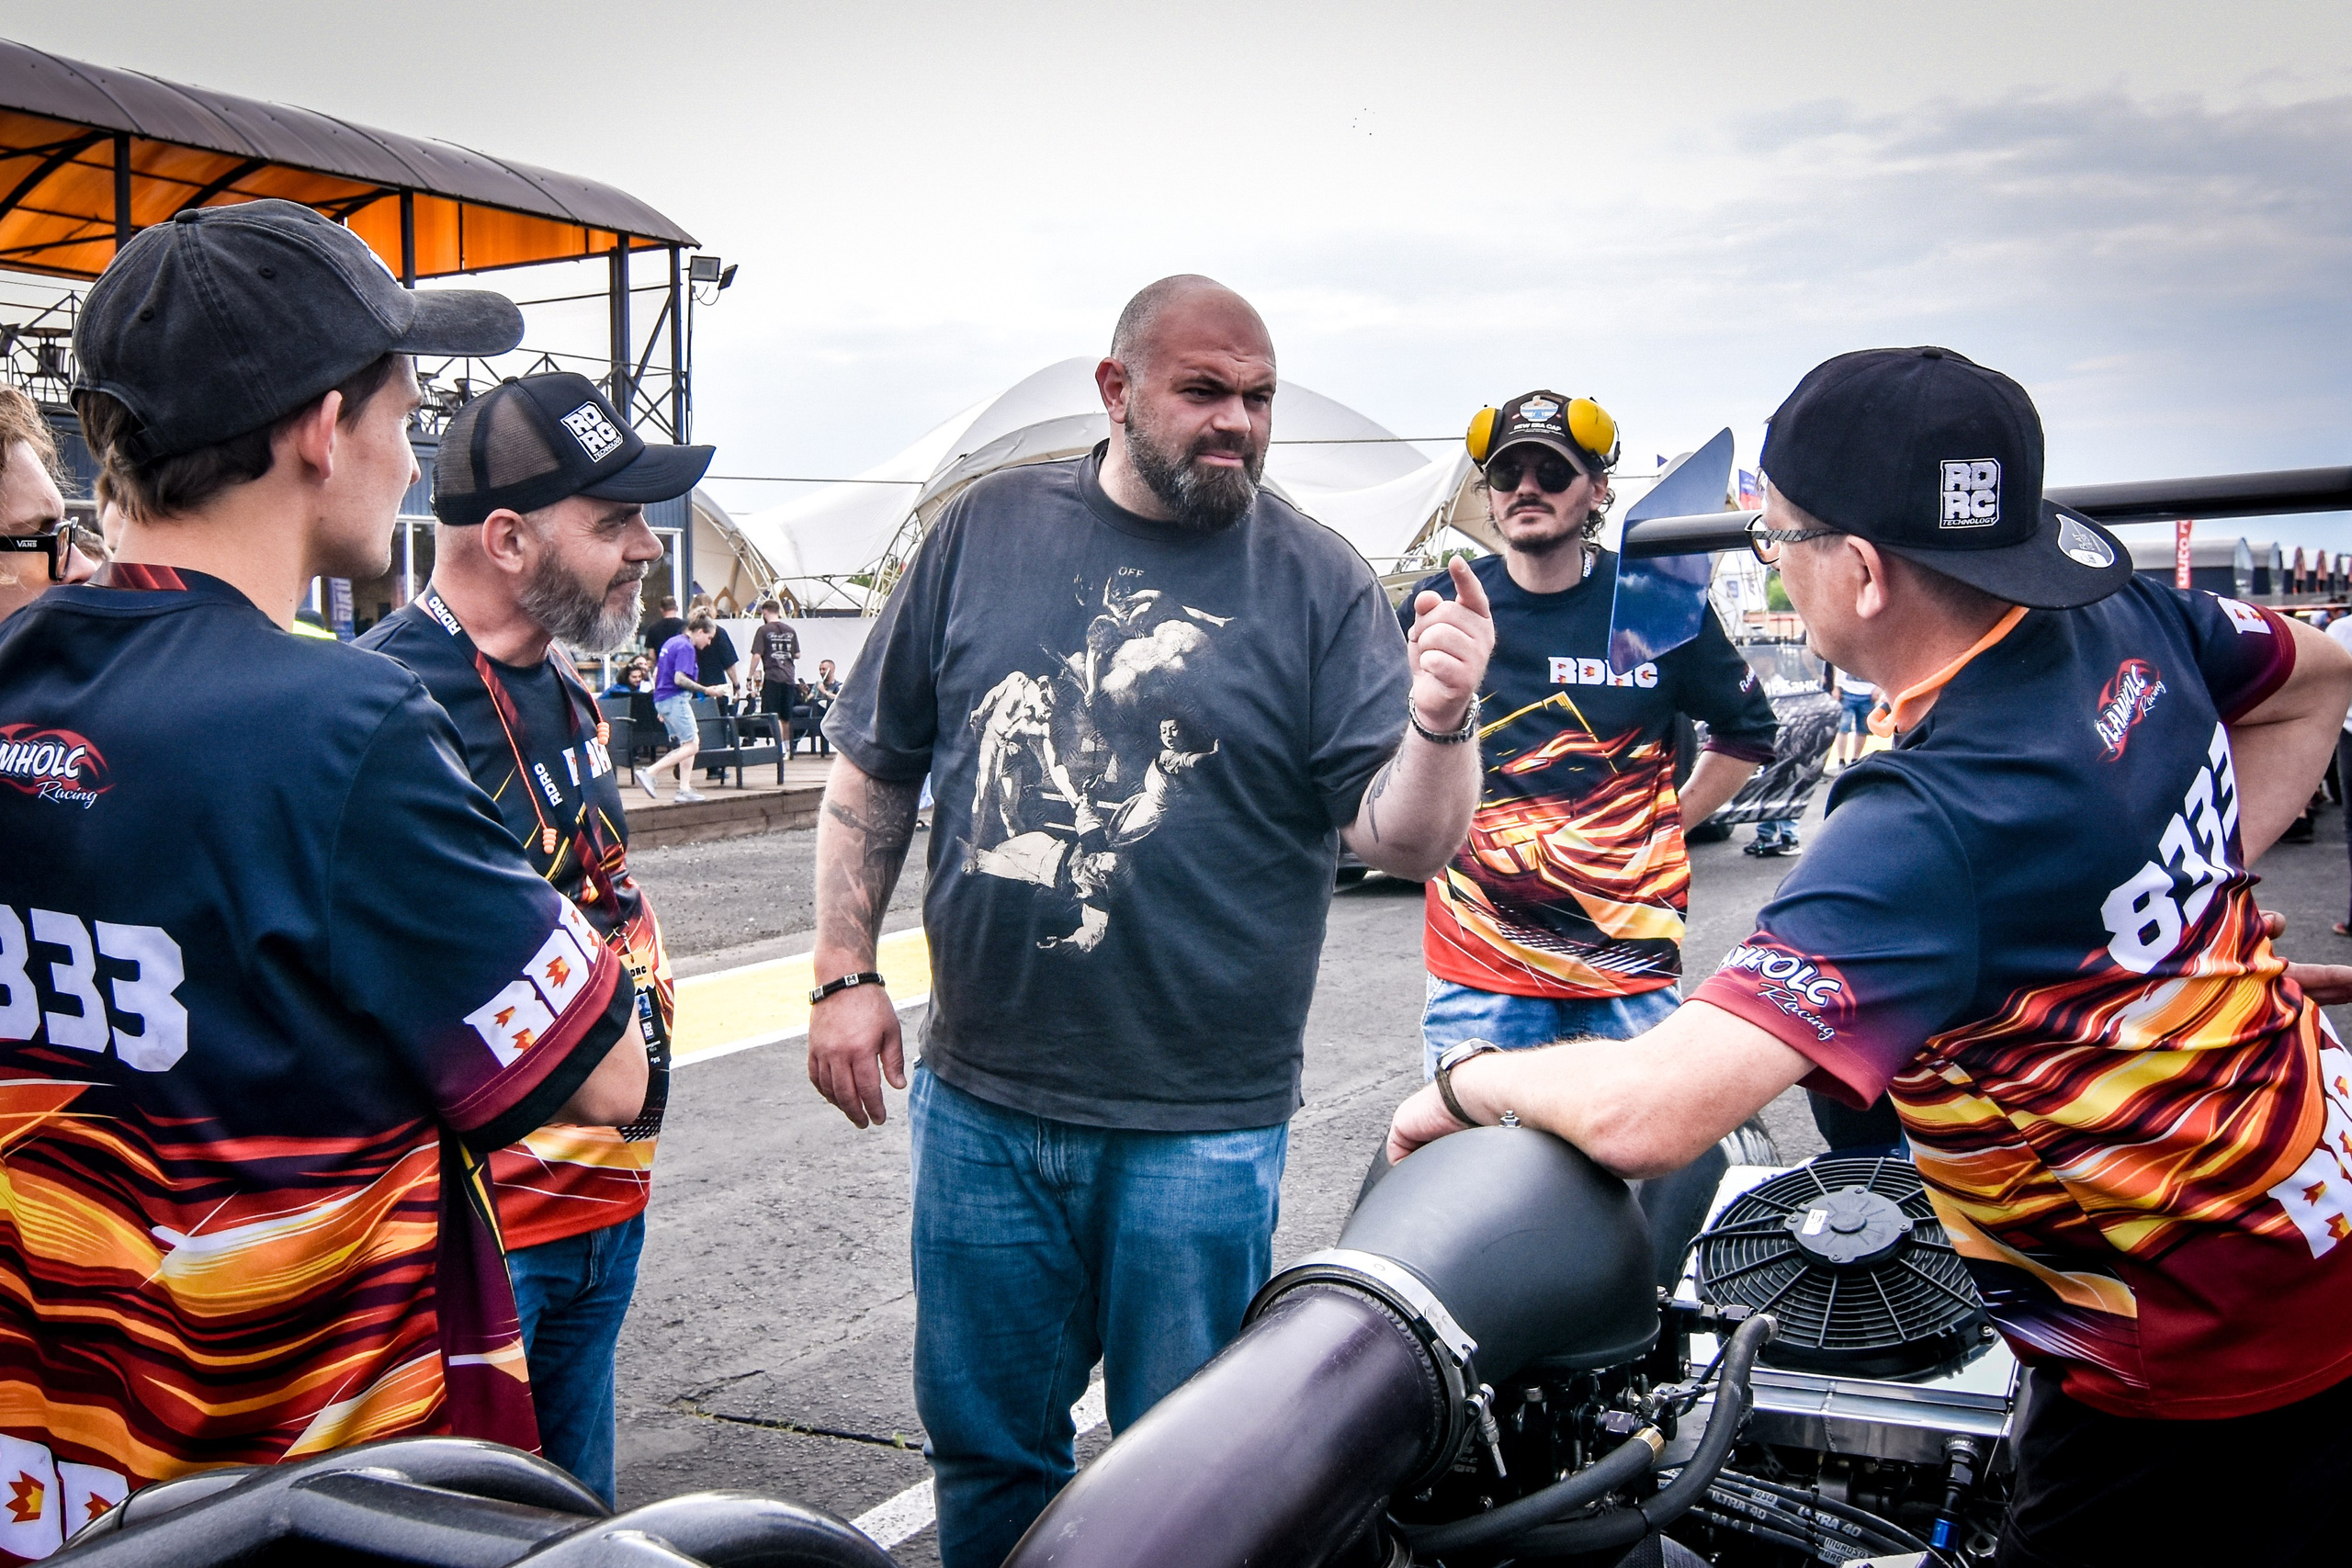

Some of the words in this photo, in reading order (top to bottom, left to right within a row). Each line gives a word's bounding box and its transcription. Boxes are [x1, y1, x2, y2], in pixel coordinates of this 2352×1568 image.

[1545, 423, 1562, 432] CAP
[1942, 516, 1996, 526] TECHNOLOGY
[17, 539, 38, 547] VANS
[1118, 566, 1145, 578] OFF
[428, 595, 462, 637] RDRC
[2138, 680, 2166, 717] Racing
[36, 780, 98, 809] Racing
[534, 762, 563, 807] RDRC
[1757, 982, 1836, 1041] Racing
[1826, 1539, 1866, 1559] MOROSO
